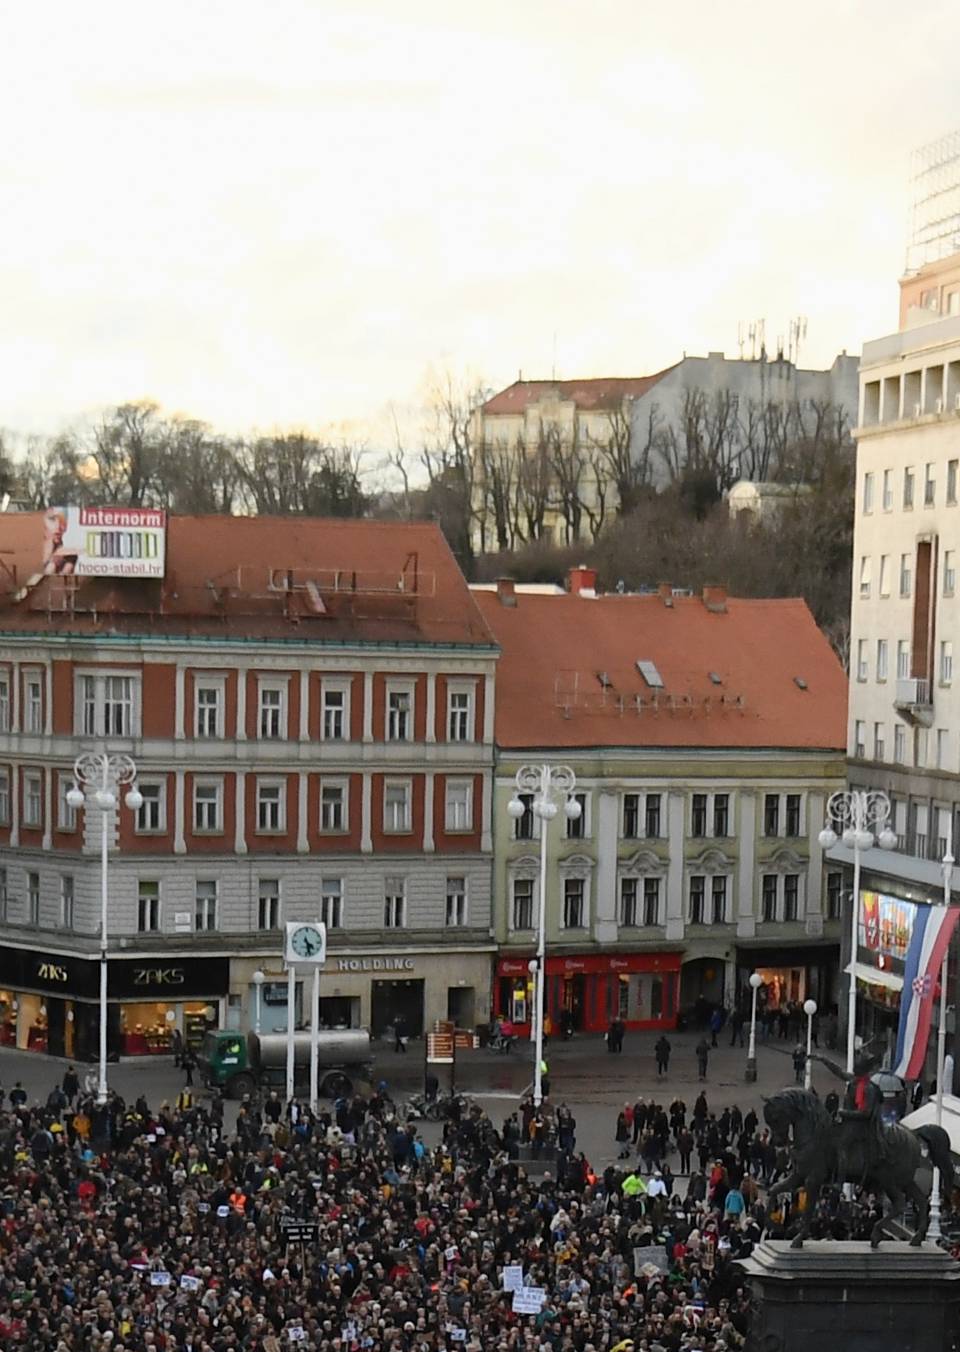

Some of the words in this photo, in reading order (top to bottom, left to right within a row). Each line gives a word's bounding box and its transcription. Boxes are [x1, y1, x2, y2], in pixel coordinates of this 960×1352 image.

[82, 510, 161, 526] Internorm
[339, 958, 415, 971] HOLDING
[133, 968, 184, 985] ZAKS
